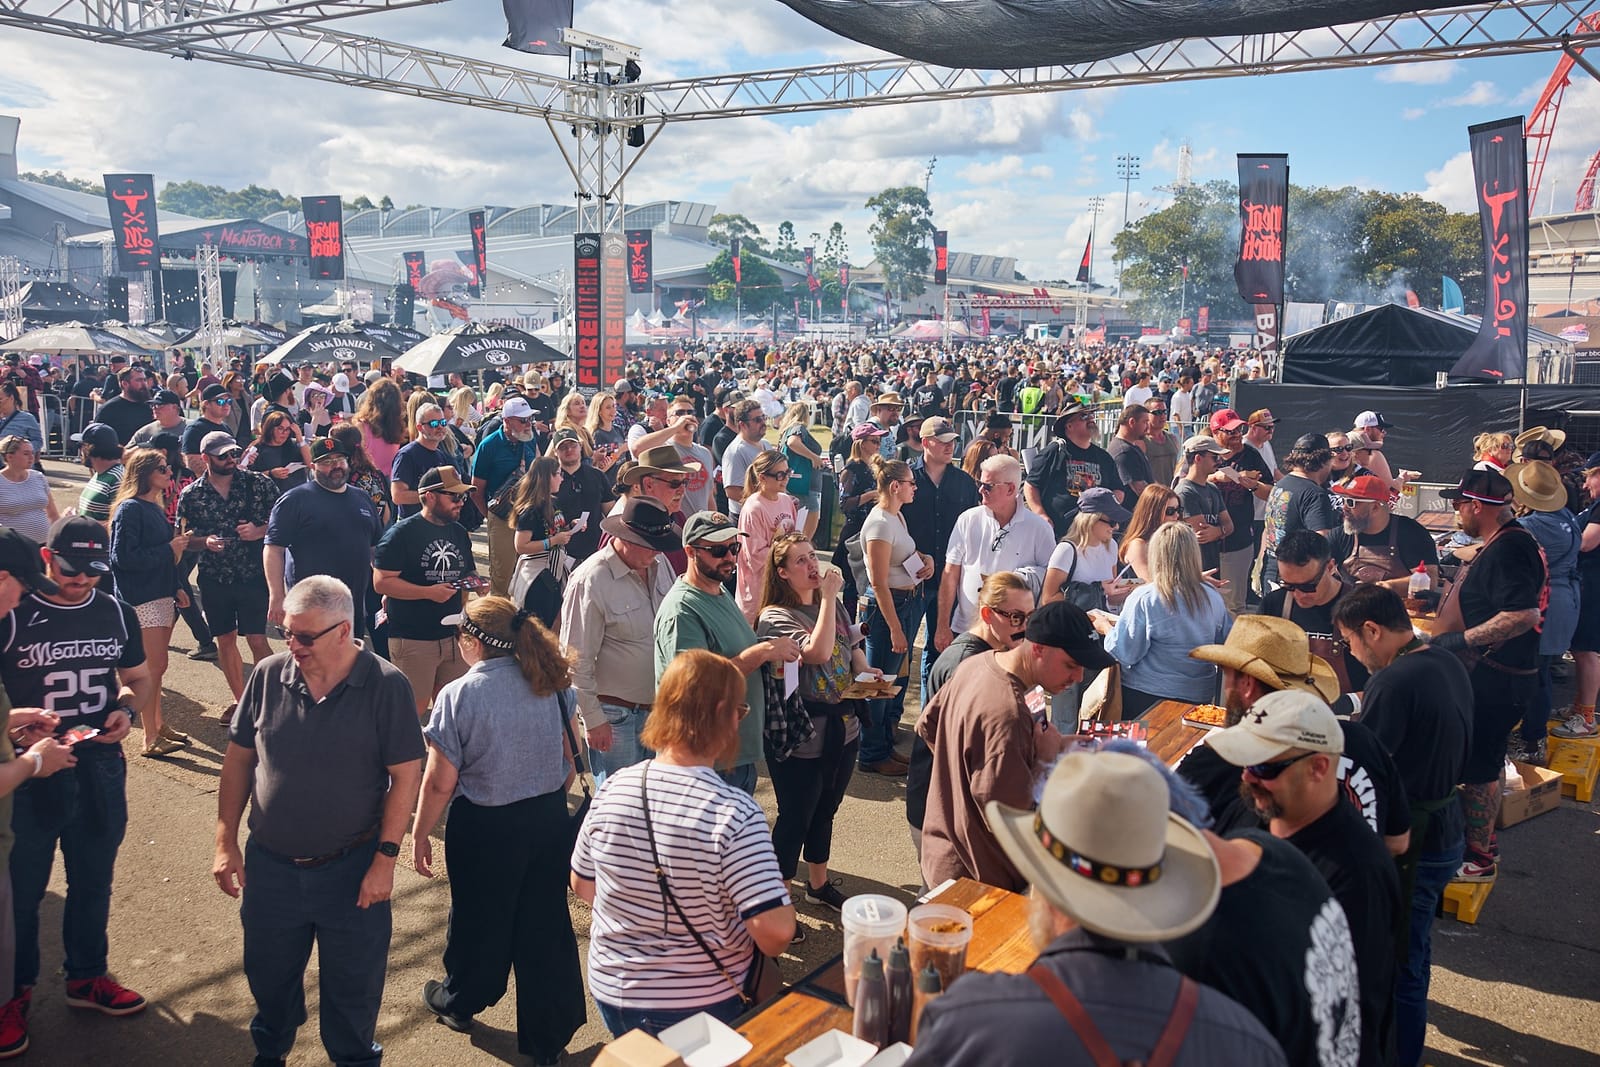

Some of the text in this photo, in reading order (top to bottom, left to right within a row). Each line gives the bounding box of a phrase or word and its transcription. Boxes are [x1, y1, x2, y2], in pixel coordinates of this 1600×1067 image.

[308, 337, 376, 353] JACK DANIEL'S
[456, 338, 528, 358] JACK DANIEL'S
[17, 638, 124, 669] Meatstock
[44, 667, 110, 718] 25
